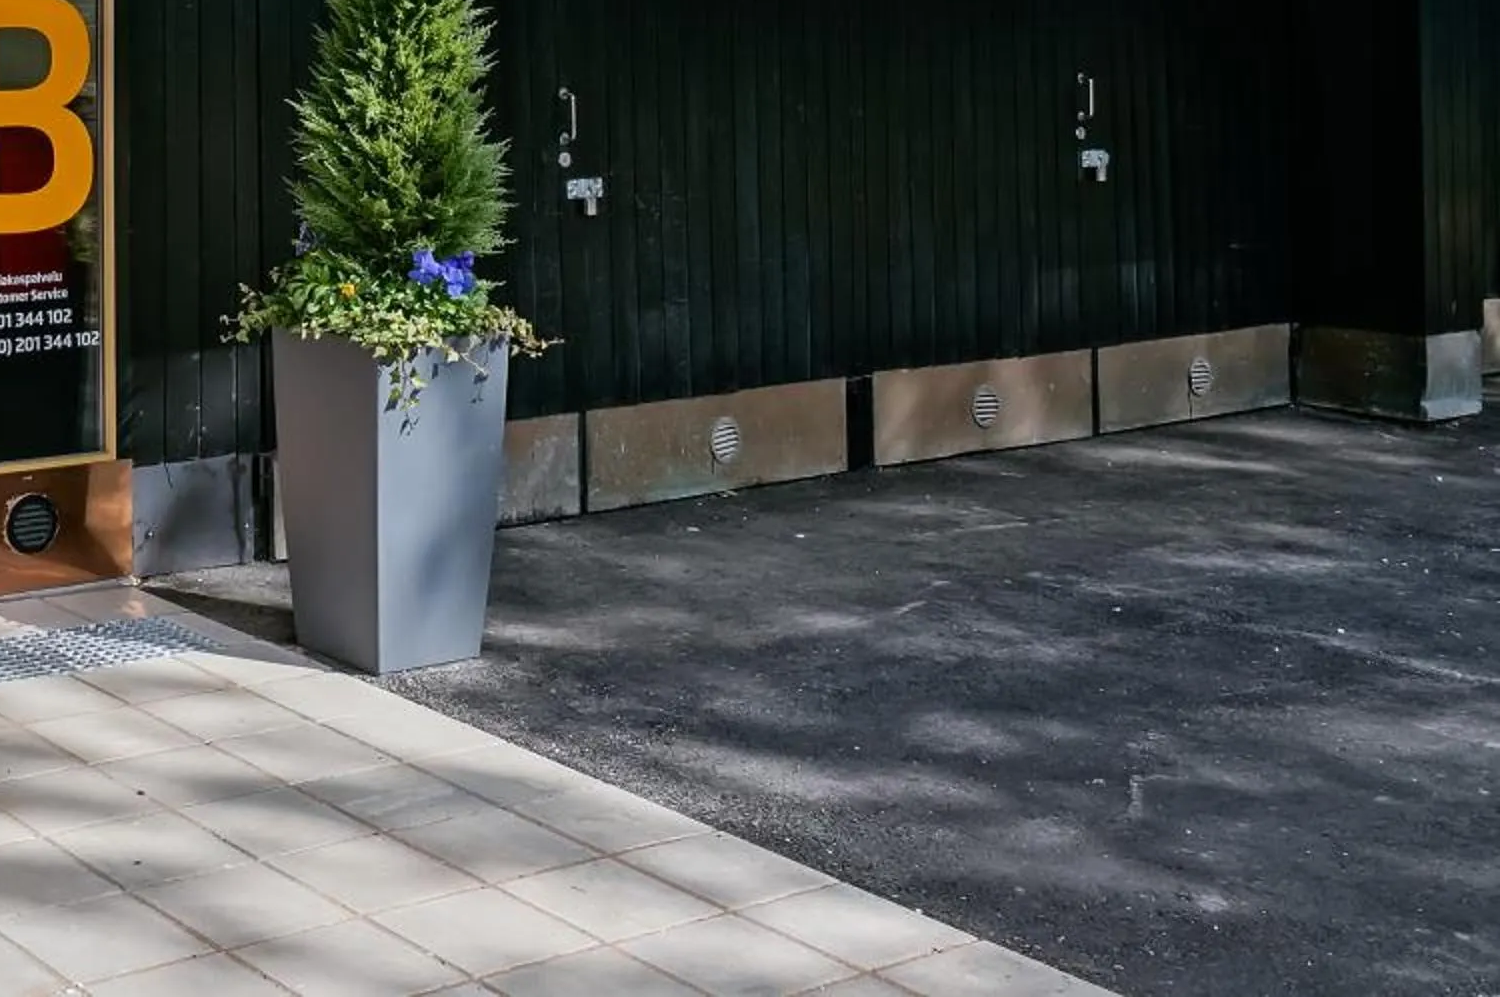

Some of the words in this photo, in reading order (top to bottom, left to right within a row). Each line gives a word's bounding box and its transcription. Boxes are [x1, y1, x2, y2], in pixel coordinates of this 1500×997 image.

[31, 287, 69, 302] Service
[15, 311, 44, 328] 344
[48, 308, 73, 324] 102
[15, 335, 41, 353] 201
[43, 332, 72, 350] 344
[75, 330, 100, 346] 102
